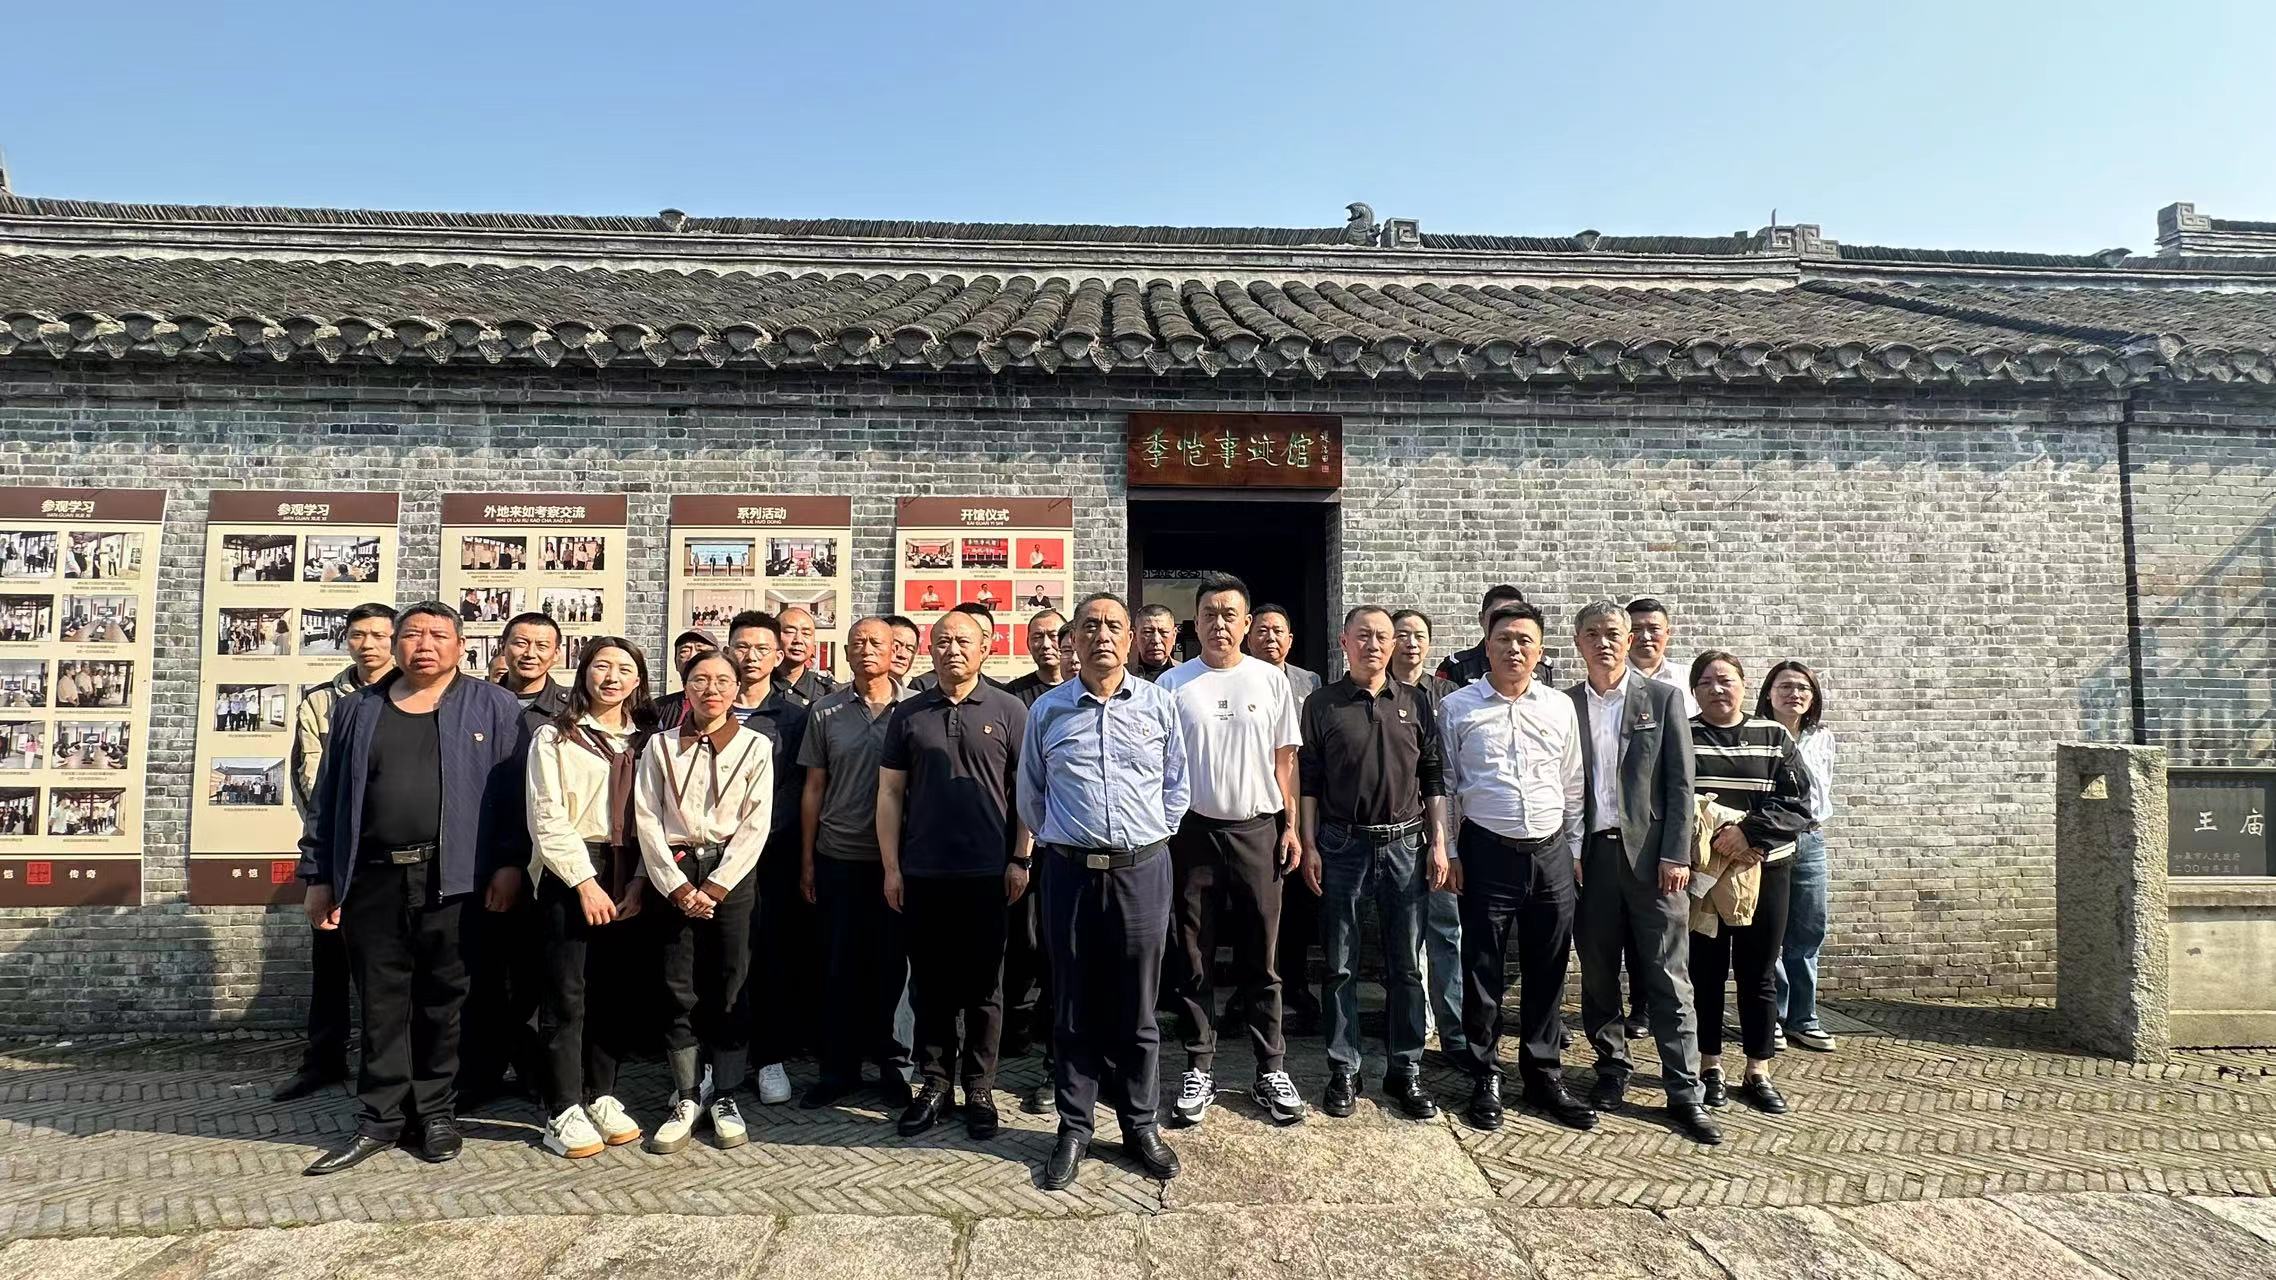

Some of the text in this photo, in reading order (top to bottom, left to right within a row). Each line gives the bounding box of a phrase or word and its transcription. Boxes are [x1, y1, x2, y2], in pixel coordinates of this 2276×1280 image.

[1142, 428, 1314, 469] 季恺事迹馆
[41, 499, 96, 513] 参观学习
[277, 502, 330, 516] 参观学习
[483, 505, 586, 519] 外地来如考察交流
[736, 506, 787, 520] 系列活动
[960, 508, 1010, 522] 开馆仪式
